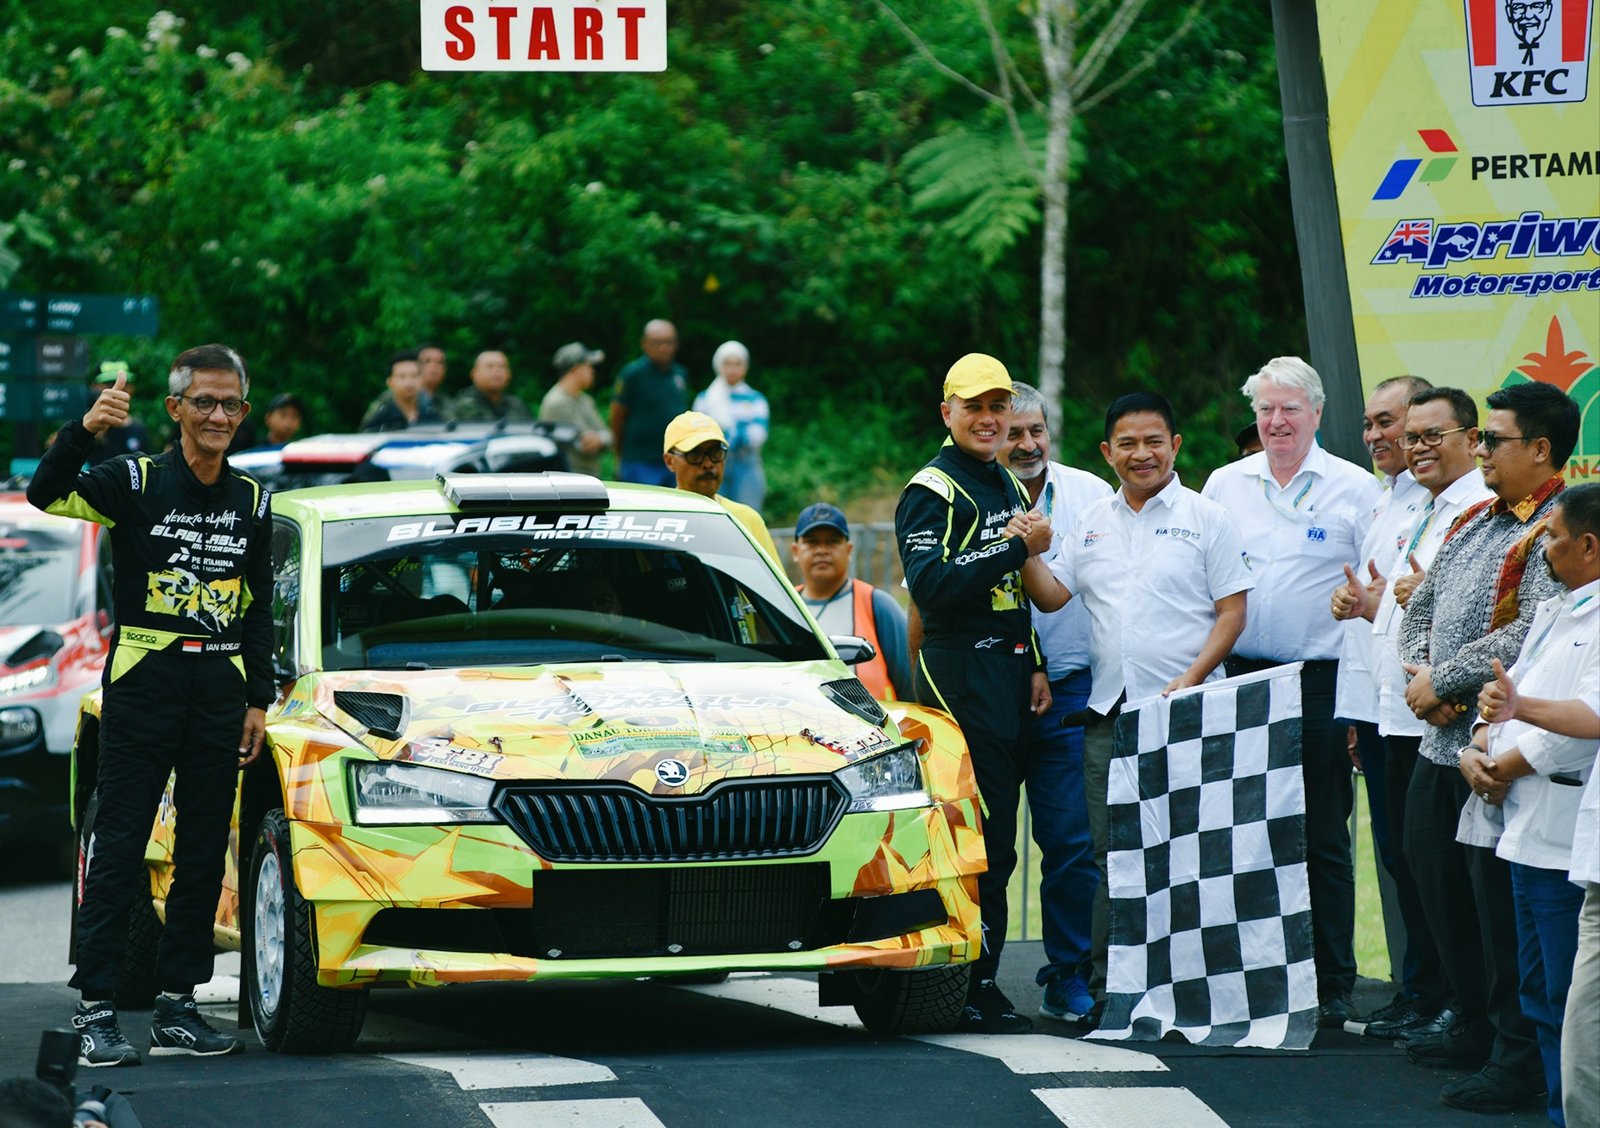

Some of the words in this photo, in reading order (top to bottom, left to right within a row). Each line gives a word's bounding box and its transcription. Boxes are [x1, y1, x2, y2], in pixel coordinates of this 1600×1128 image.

[444, 6, 646, 61] START
[1490, 69, 1569, 98] KFC
[126, 459, 140, 491] sparco
[387, 515, 687, 541] BLABLABLA
[533, 530, 695, 542] MOTOSPORT
[1307, 529, 1325, 541] FIA
[126, 631, 157, 643] sparco
[206, 643, 219, 651] IAN
[574, 727, 621, 743] DANAU
